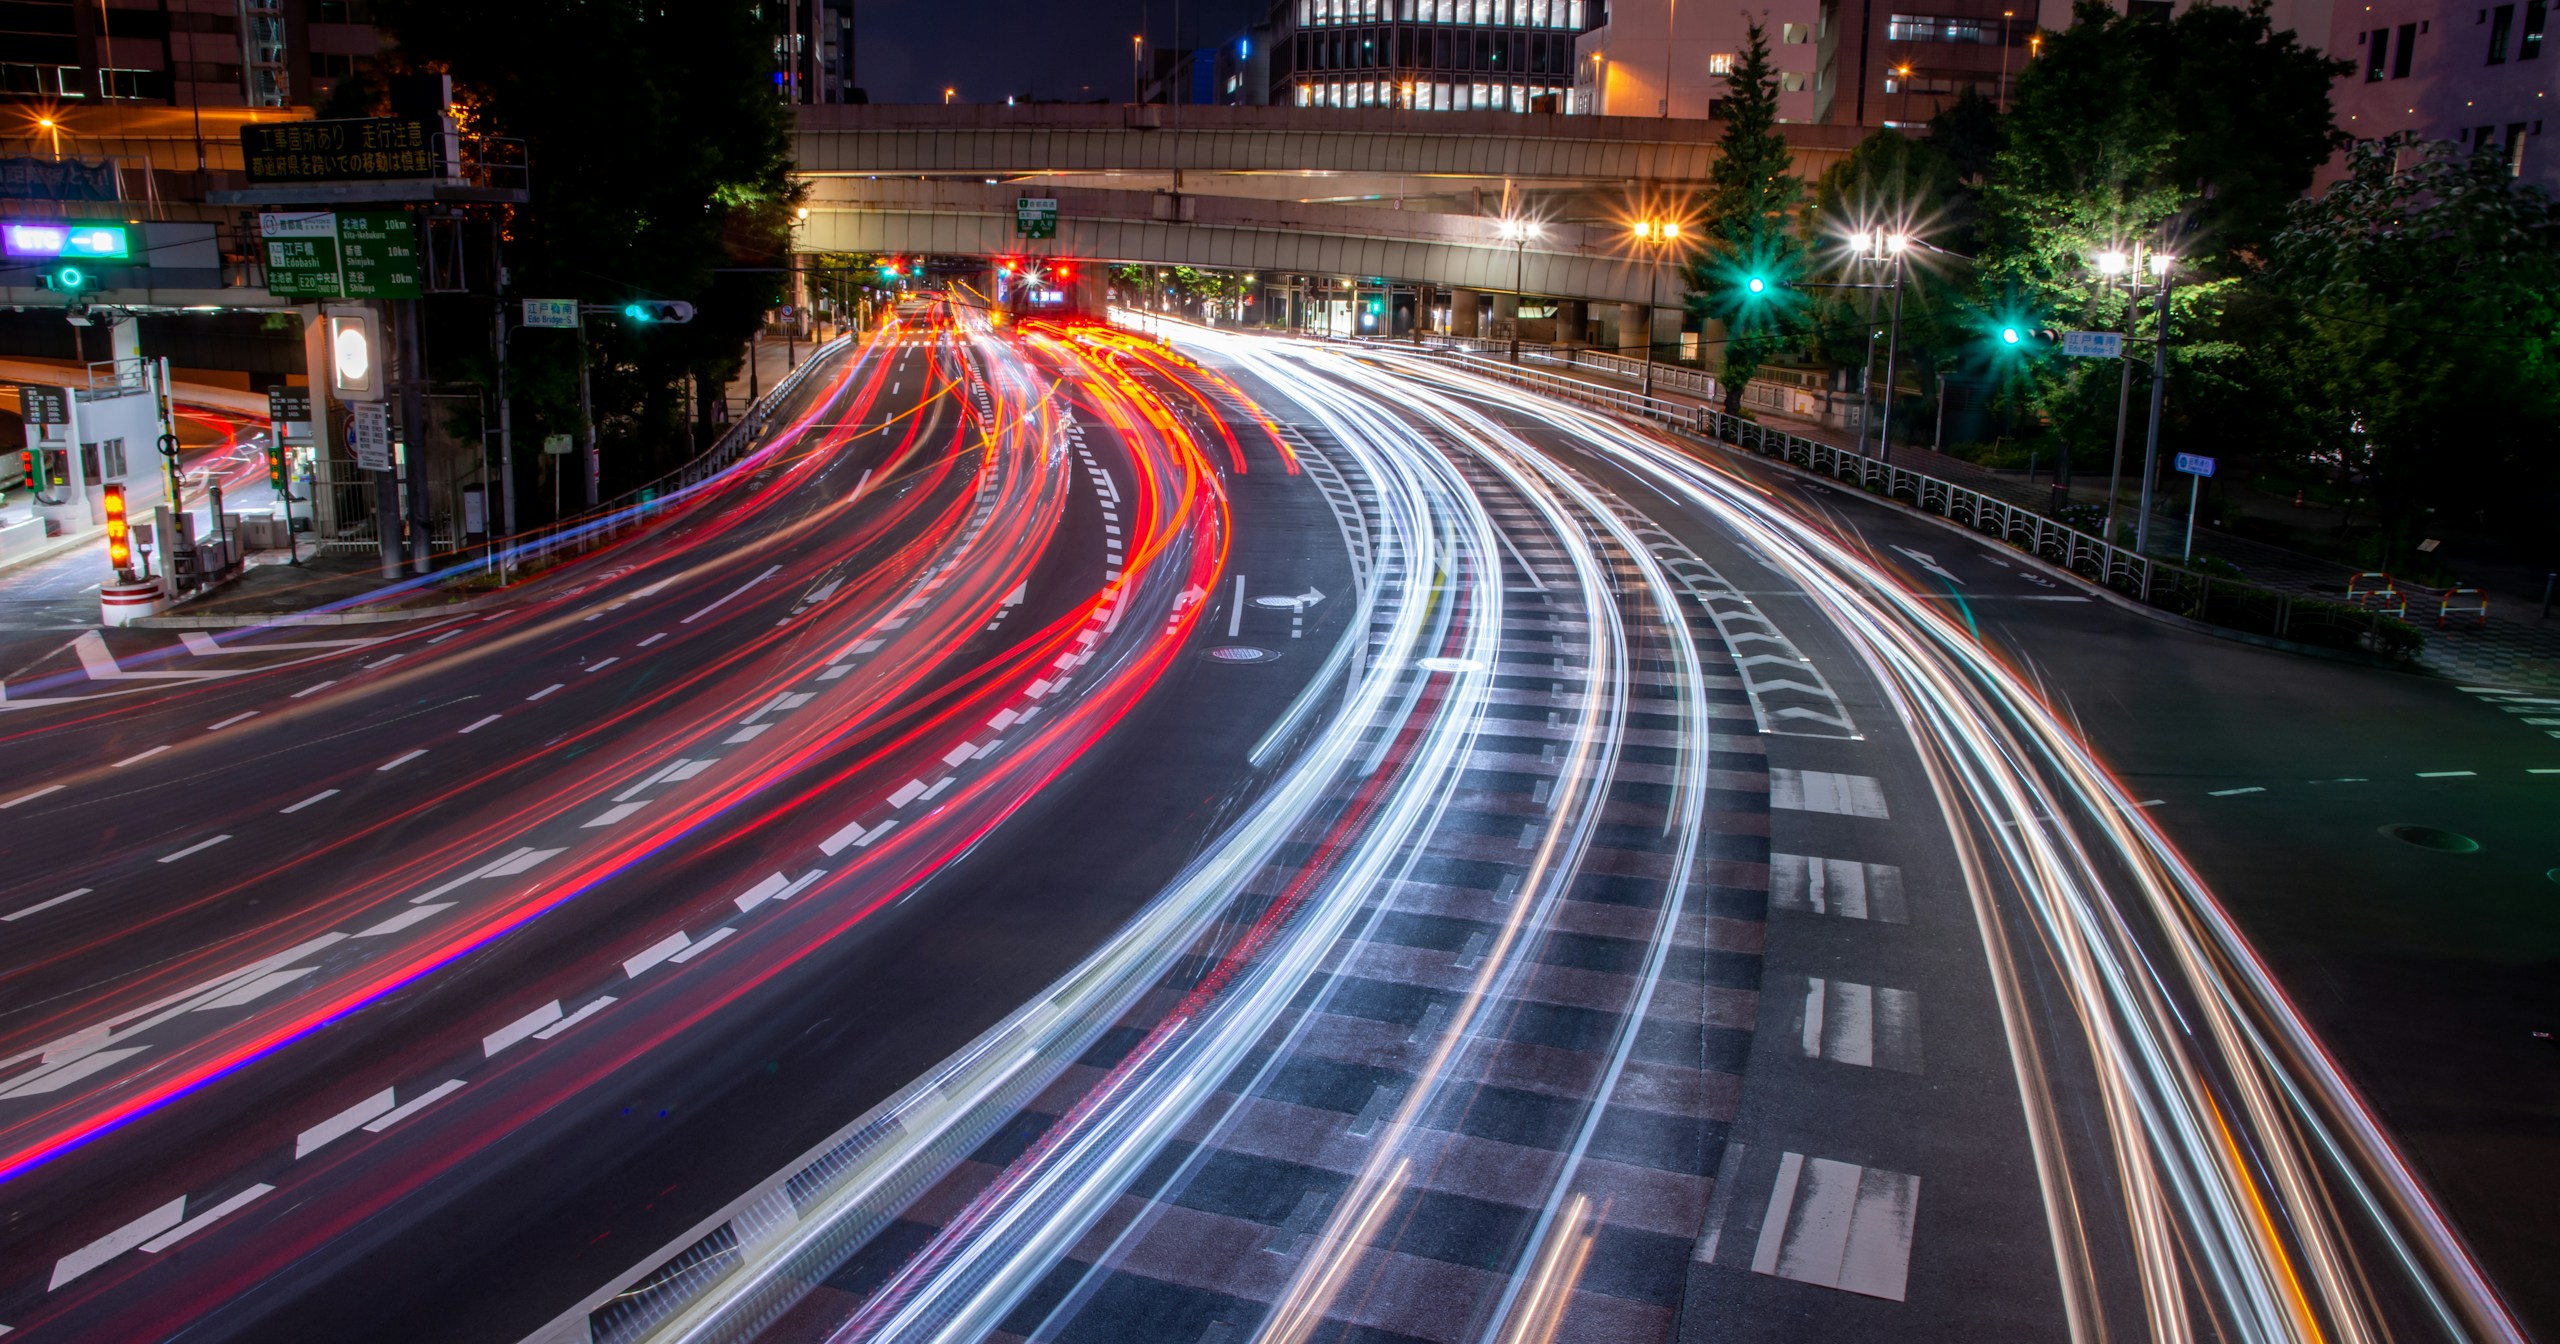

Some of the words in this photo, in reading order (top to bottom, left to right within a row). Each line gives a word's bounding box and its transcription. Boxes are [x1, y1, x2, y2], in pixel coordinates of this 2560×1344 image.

[259, 124, 345, 151] 工事箇所あり
[362, 121, 423, 149] 走行注意
[342, 217, 368, 230] 北池袋
[385, 219, 407, 230] 10km
[284, 242, 315, 256] 江戸橋
[345, 244, 363, 257] 新宿
[388, 246, 410, 257] 10km
[273, 255, 283, 265] 31
[285, 257, 320, 268] Edobashi
[346, 257, 375, 268] Shinjuku
[269, 271, 294, 284] 北池袋
[299, 276, 316, 288] E20
[316, 272, 338, 284] 中央道
[348, 271, 365, 283] 渋谷
[391, 273, 413, 284] 10km
[349, 283, 376, 295] Shibuya
[528, 303, 572, 315] 江戸橋南
[528, 315, 540, 323] Edo
